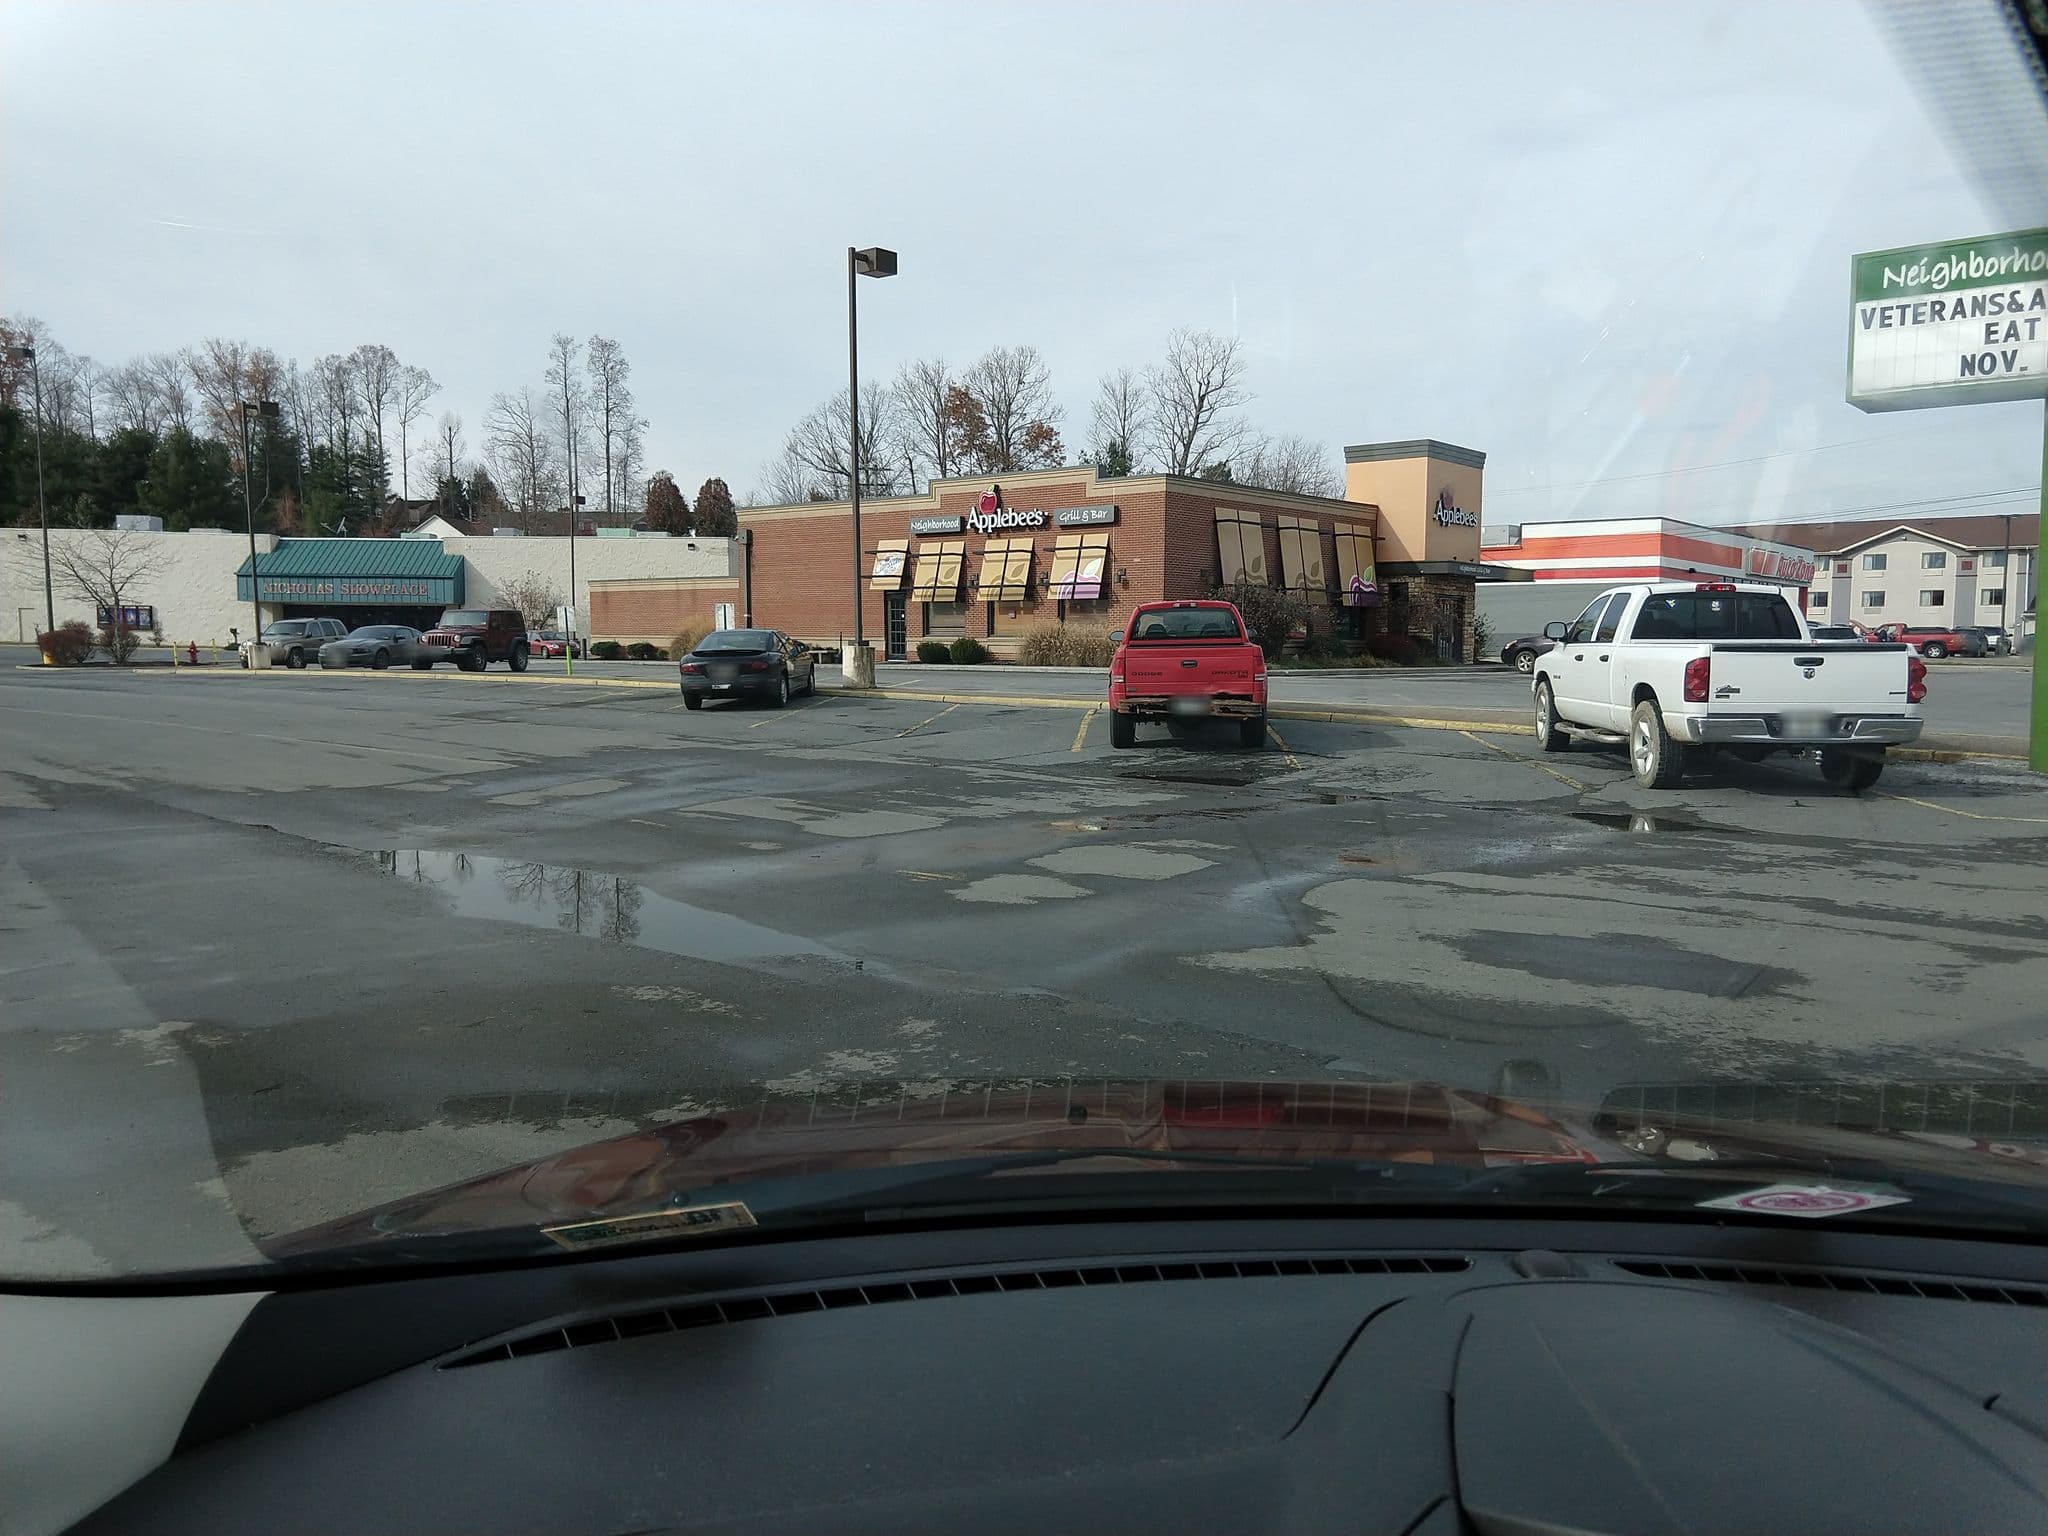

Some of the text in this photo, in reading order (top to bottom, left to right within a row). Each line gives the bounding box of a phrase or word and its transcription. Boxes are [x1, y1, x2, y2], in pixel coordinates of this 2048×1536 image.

[1882, 246, 2048, 290] Neighborho
[1984, 317, 2042, 345] EAT
[1059, 509, 1108, 523] Grill & Bar
[910, 518, 960, 532] Neighborhood
[263, 583, 334, 594] NICHOLAS
